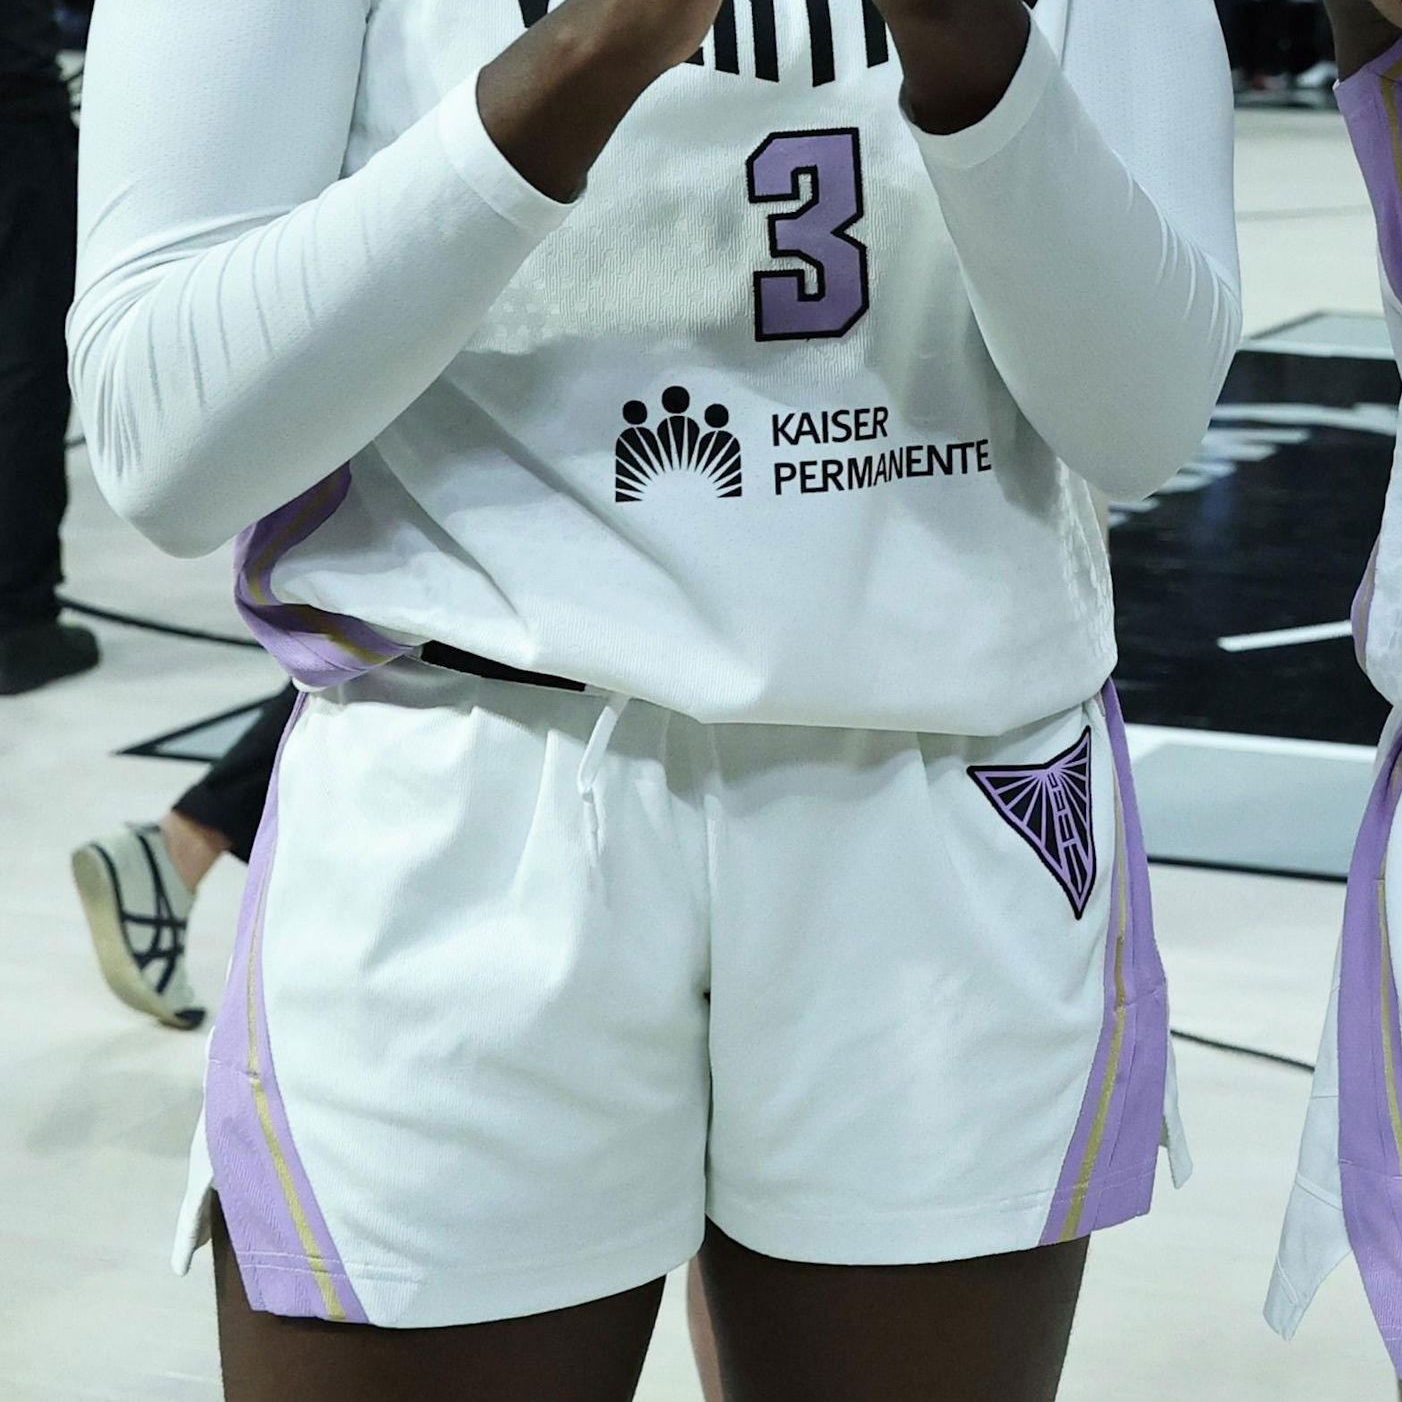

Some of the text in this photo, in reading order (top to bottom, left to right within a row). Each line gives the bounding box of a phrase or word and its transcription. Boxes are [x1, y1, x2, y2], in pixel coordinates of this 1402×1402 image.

[745, 127, 870, 342] 3
[772, 406, 889, 447] KAISER
[774, 438, 992, 496] PERMANENTE
